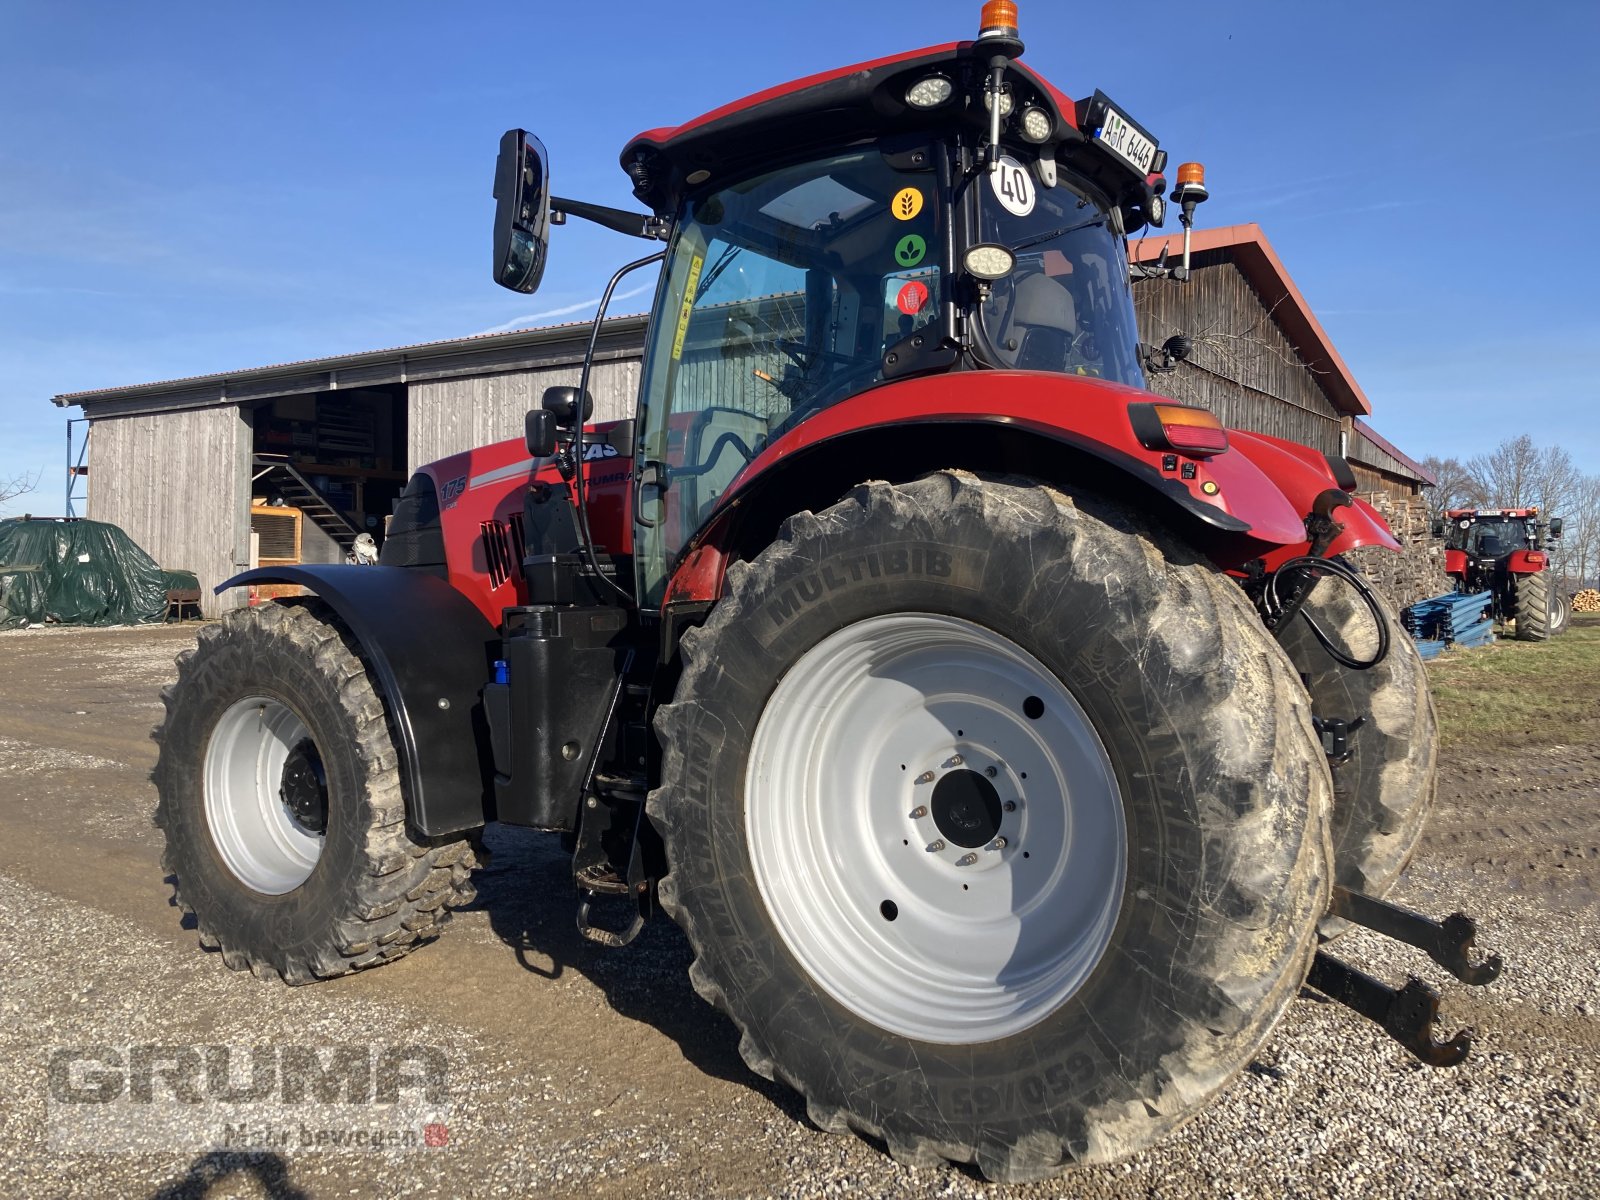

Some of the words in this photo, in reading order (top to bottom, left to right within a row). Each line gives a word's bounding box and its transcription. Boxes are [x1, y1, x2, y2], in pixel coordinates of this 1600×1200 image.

[1127, 133, 1151, 169] 6446
[1000, 164, 1027, 206] 40
[570, 443, 619, 461] CAS
[441, 475, 467, 501] 175
[766, 547, 953, 626] MULTIBIB
